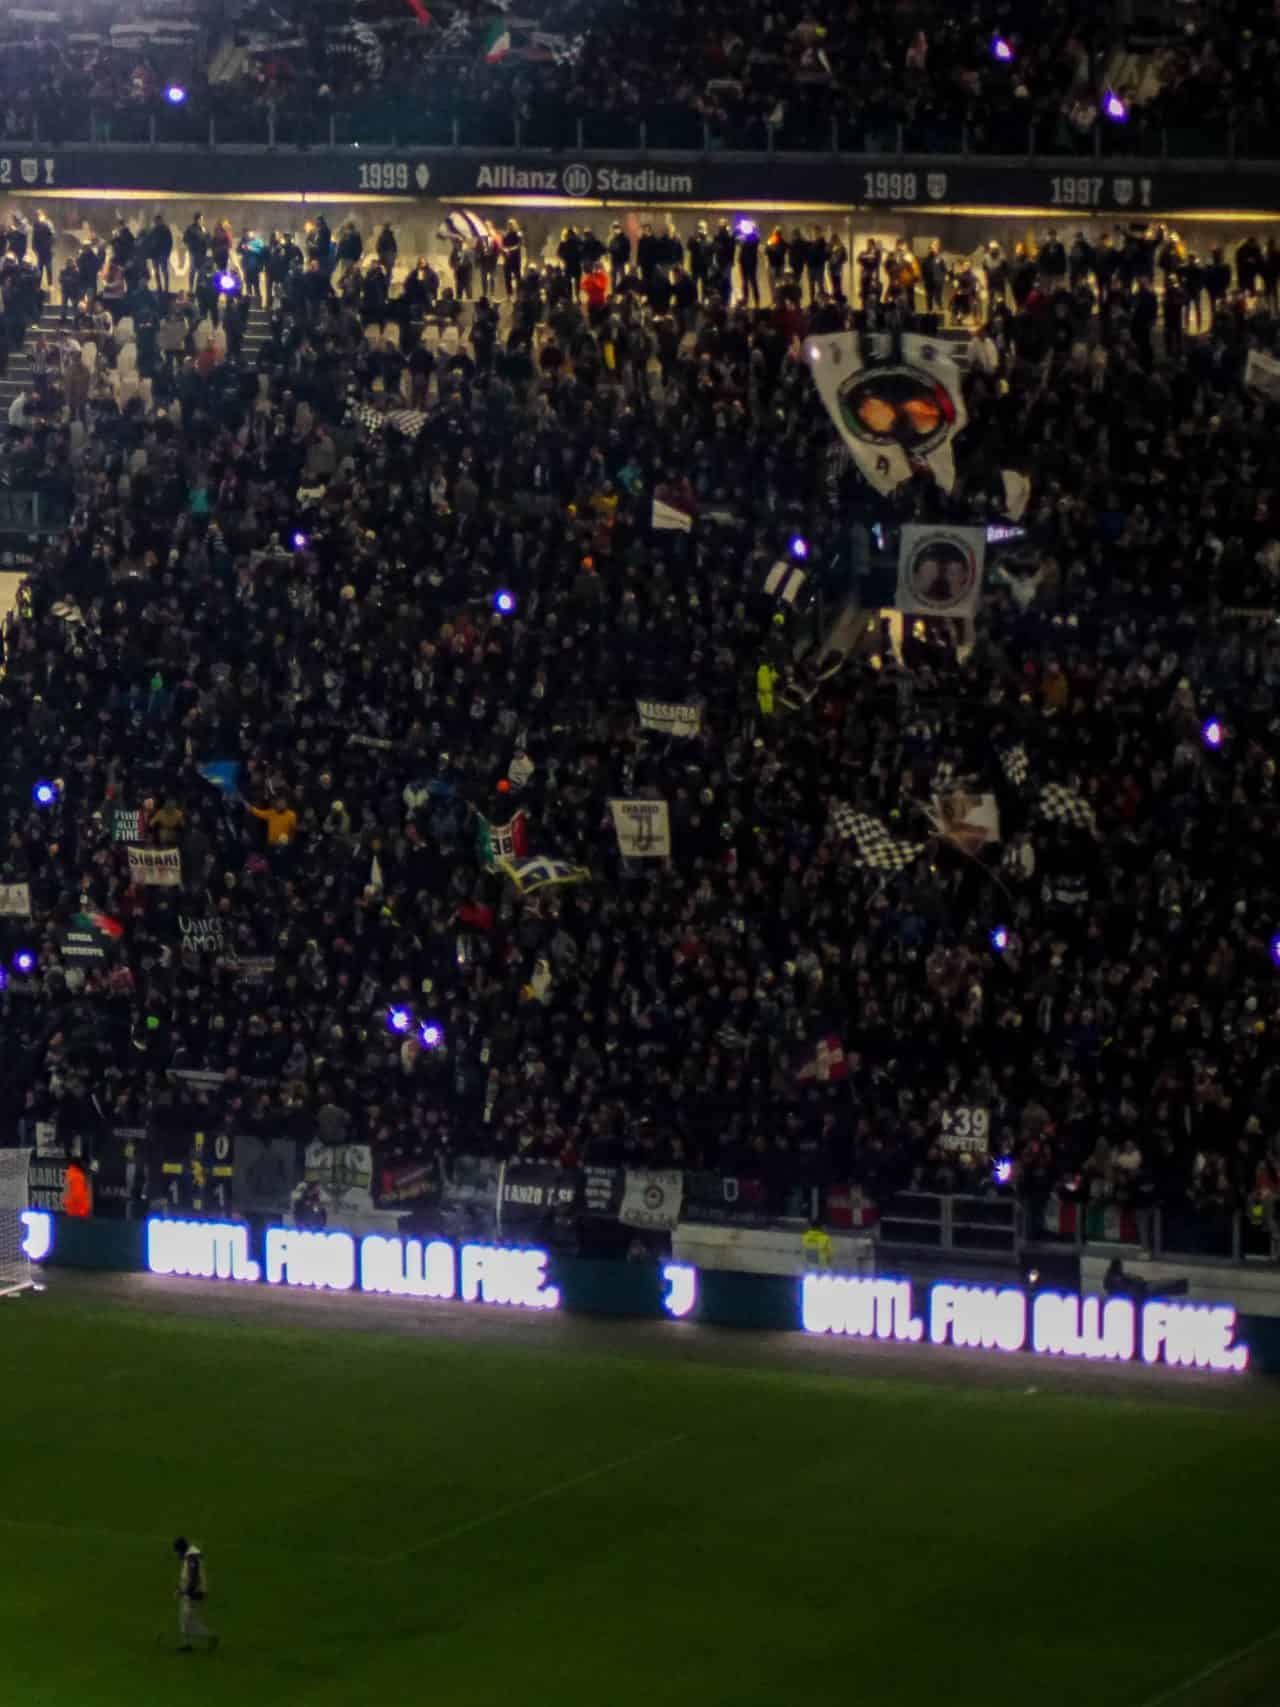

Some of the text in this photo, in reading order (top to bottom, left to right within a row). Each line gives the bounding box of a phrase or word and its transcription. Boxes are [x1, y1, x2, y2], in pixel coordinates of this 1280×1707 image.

[359, 163, 407, 189] 1999
[476, 165, 693, 192] Allianz Stadium
[864, 172, 917, 200] 1998
[1051, 177, 1104, 204] 1997
[267, 1228, 354, 1289] FINO
[362, 1236, 454, 1297] ALLA
[463, 1245, 559, 1307] FINE.
[932, 1286, 1024, 1350] FINO
[1034, 1294, 1133, 1359] ALLA
[1144, 1304, 1247, 1369] FINE.
